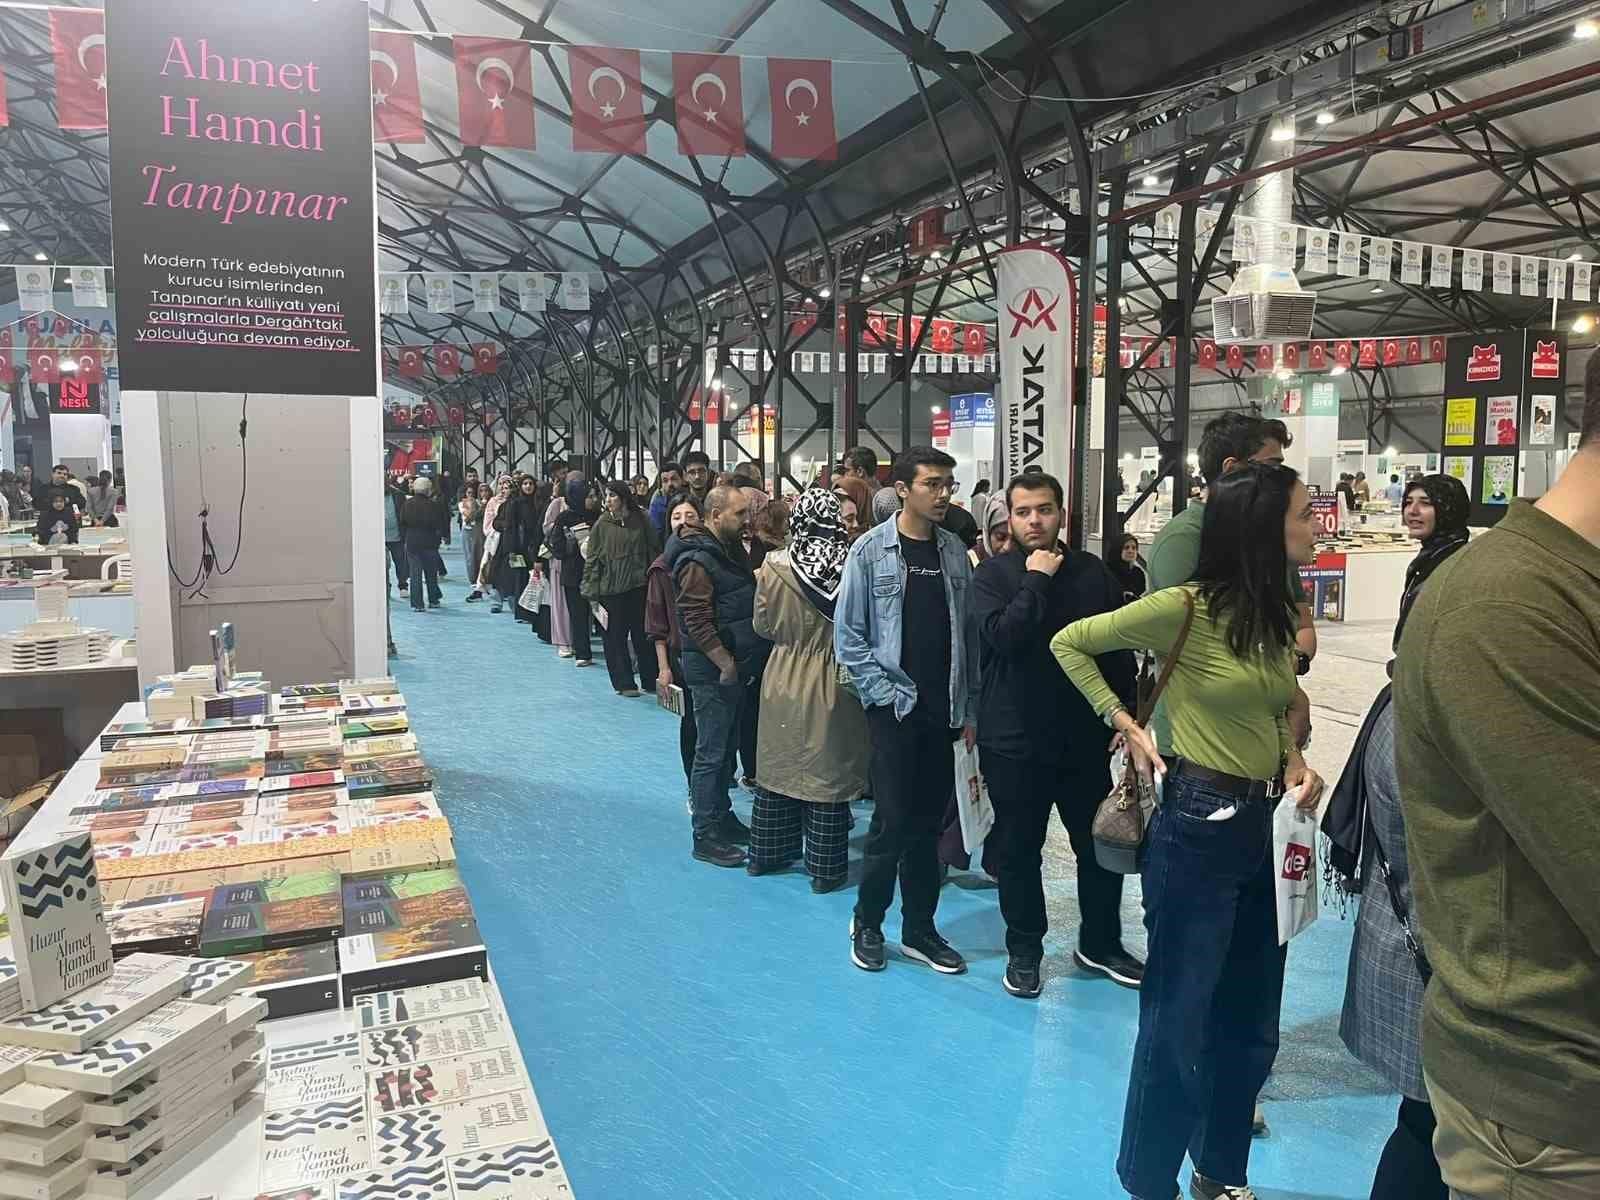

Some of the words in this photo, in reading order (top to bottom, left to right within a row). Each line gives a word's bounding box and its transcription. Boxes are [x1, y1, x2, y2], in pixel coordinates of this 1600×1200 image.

[160, 37, 321, 94] Ahmet
[160, 95, 324, 151] Hamdi
[142, 165, 348, 225] Tanpınar
[143, 253, 206, 270] Modern
[211, 256, 244, 271] Türk
[249, 260, 345, 280] edebiyatının
[168, 273, 223, 289] kurucu
[228, 275, 323, 295] isimlerinden
[151, 290, 241, 307] Tanpınar'ın
[246, 295, 304, 312] külliyatı
[307, 301, 340, 314] yeni
[149, 309, 250, 325] çalışmalarla
[255, 314, 343, 331] Dergâh'taki
[137, 327, 239, 344] yolculuğuna
[243, 330, 299, 345] devam
[303, 335, 354, 351] ediyor.
[30, 927, 66, 953] Huzur
[56, 932, 92, 961] Ahmet
[58, 944, 96, 977] Hamdi
[63, 958, 111, 991] Tanpınar
[266, 1144, 312, 1160] Huzur
